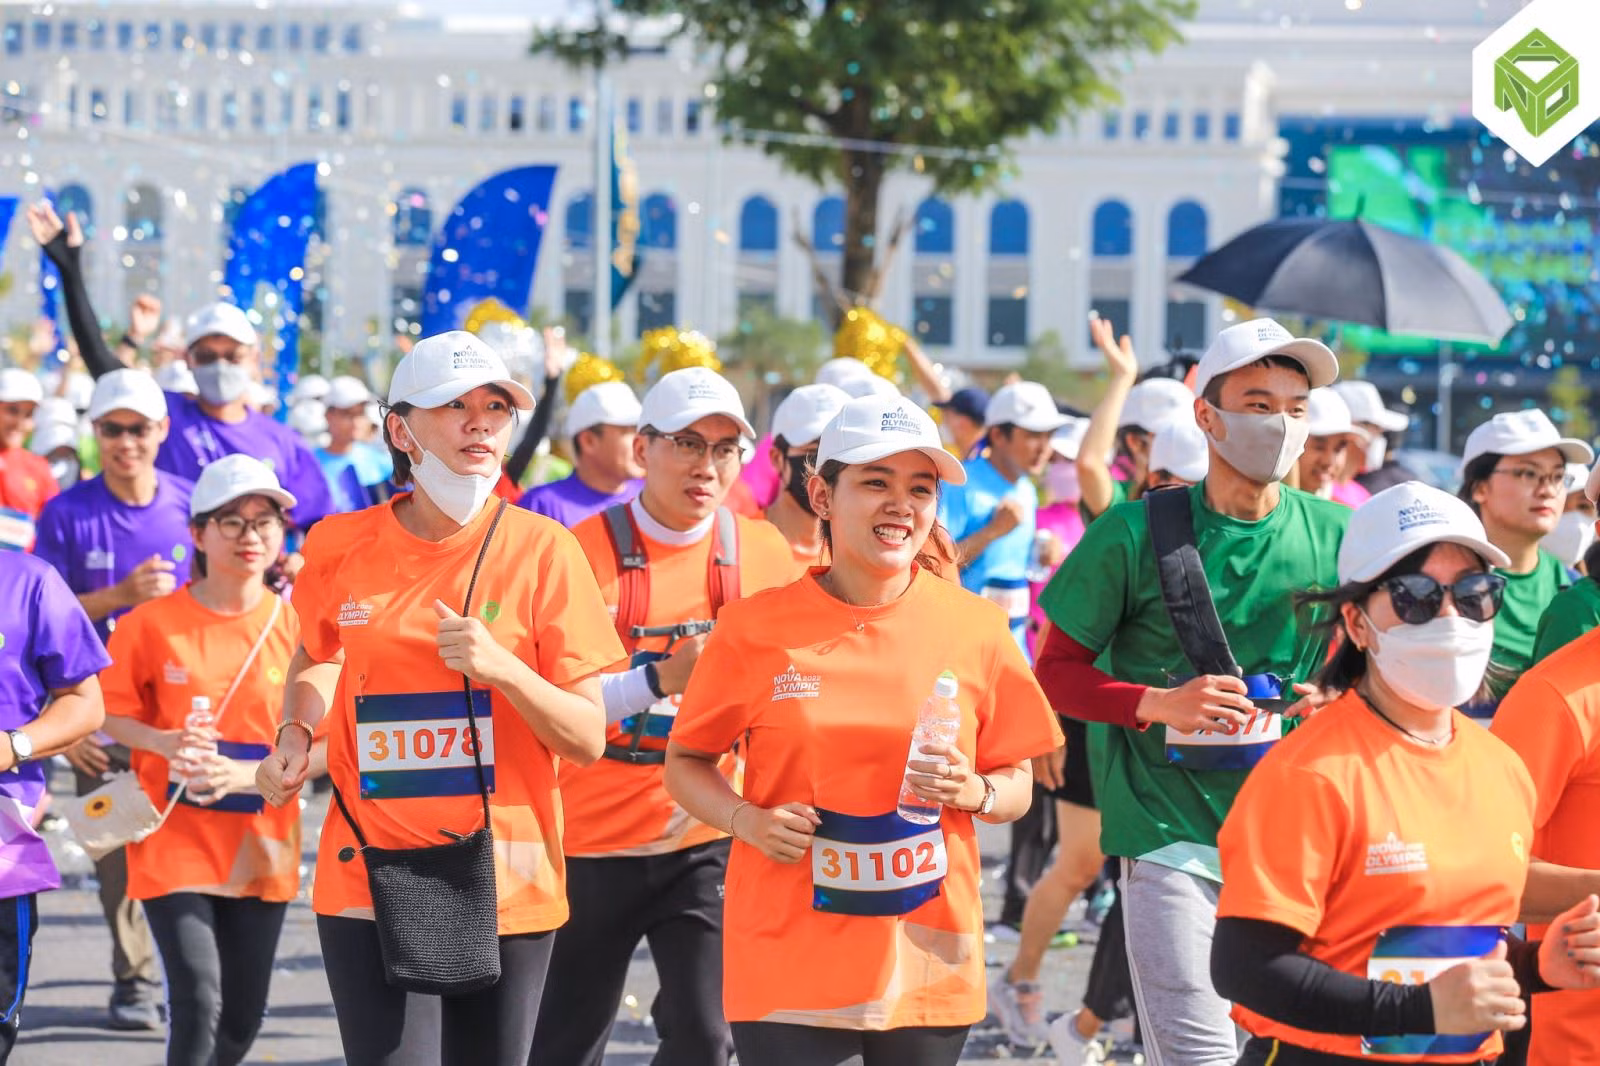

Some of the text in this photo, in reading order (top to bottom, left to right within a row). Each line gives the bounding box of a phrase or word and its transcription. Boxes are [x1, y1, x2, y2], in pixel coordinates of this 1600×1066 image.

[882, 412, 909, 420] NOVA
[881, 419, 921, 430] OLYMPIC
[773, 672, 801, 686] NOVA
[368, 726, 483, 761] 31078
[821, 841, 937, 881] 31102
